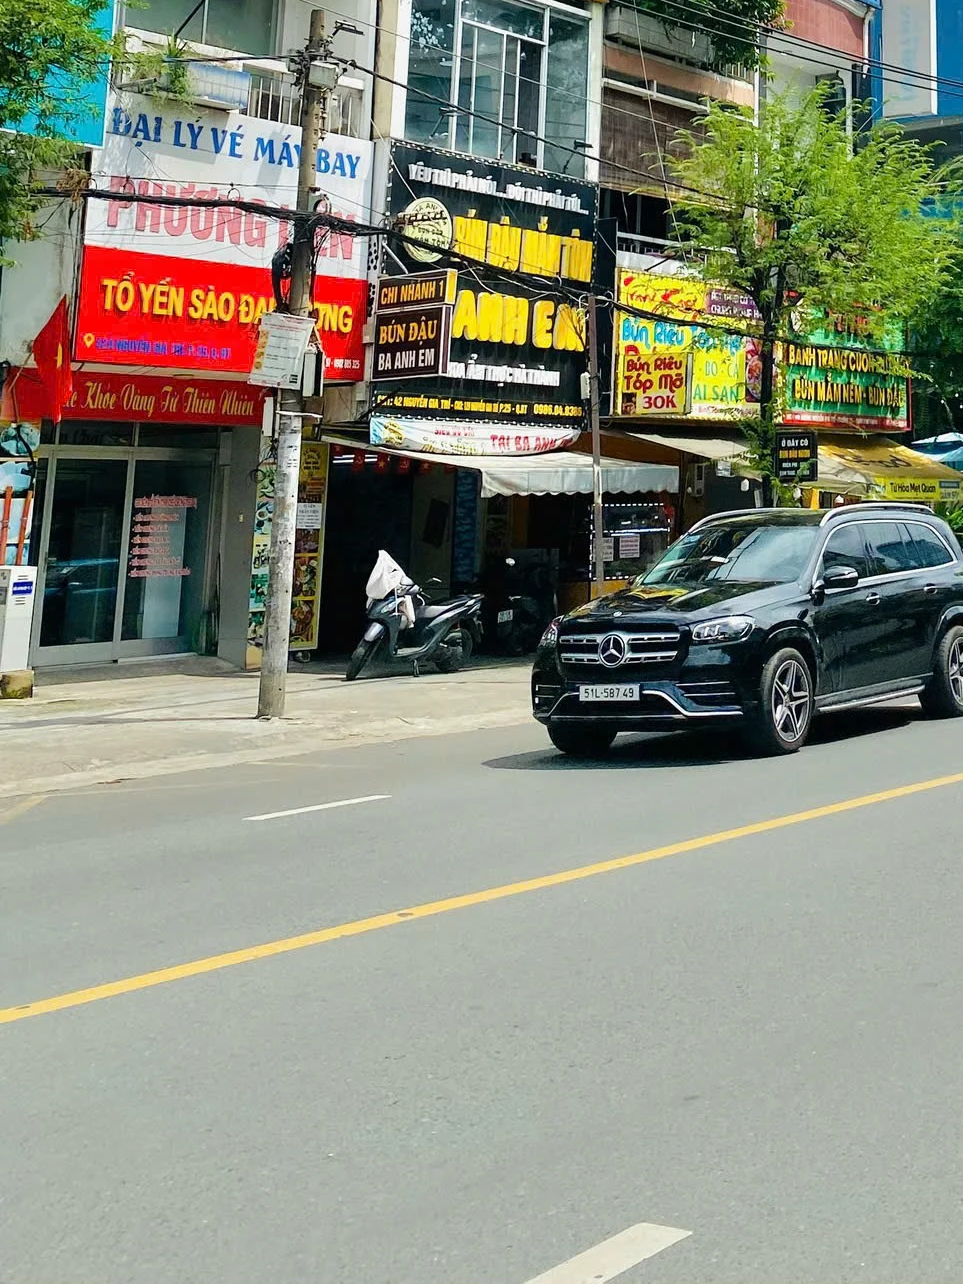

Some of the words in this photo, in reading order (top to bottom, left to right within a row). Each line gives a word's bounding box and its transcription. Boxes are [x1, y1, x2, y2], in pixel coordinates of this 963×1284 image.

[172, 118, 204, 150] LÝ
[210, 124, 244, 159] VÉ
[316, 148, 361, 179] BAY
[381, 284, 398, 305] CHI
[438, 280, 445, 297] 1
[379, 318, 405, 345] BÚN
[408, 316, 438, 346] ĐẬU
[378, 352, 393, 372] BA
[394, 349, 416, 370] ANH
[418, 348, 435, 368] EM
[626, 356, 652, 375] Bún
[653, 356, 683, 372] Riêu
[623, 371, 654, 395] Tóp
[658, 373, 684, 394] Mỡ
[642, 395, 677, 410] 30K
